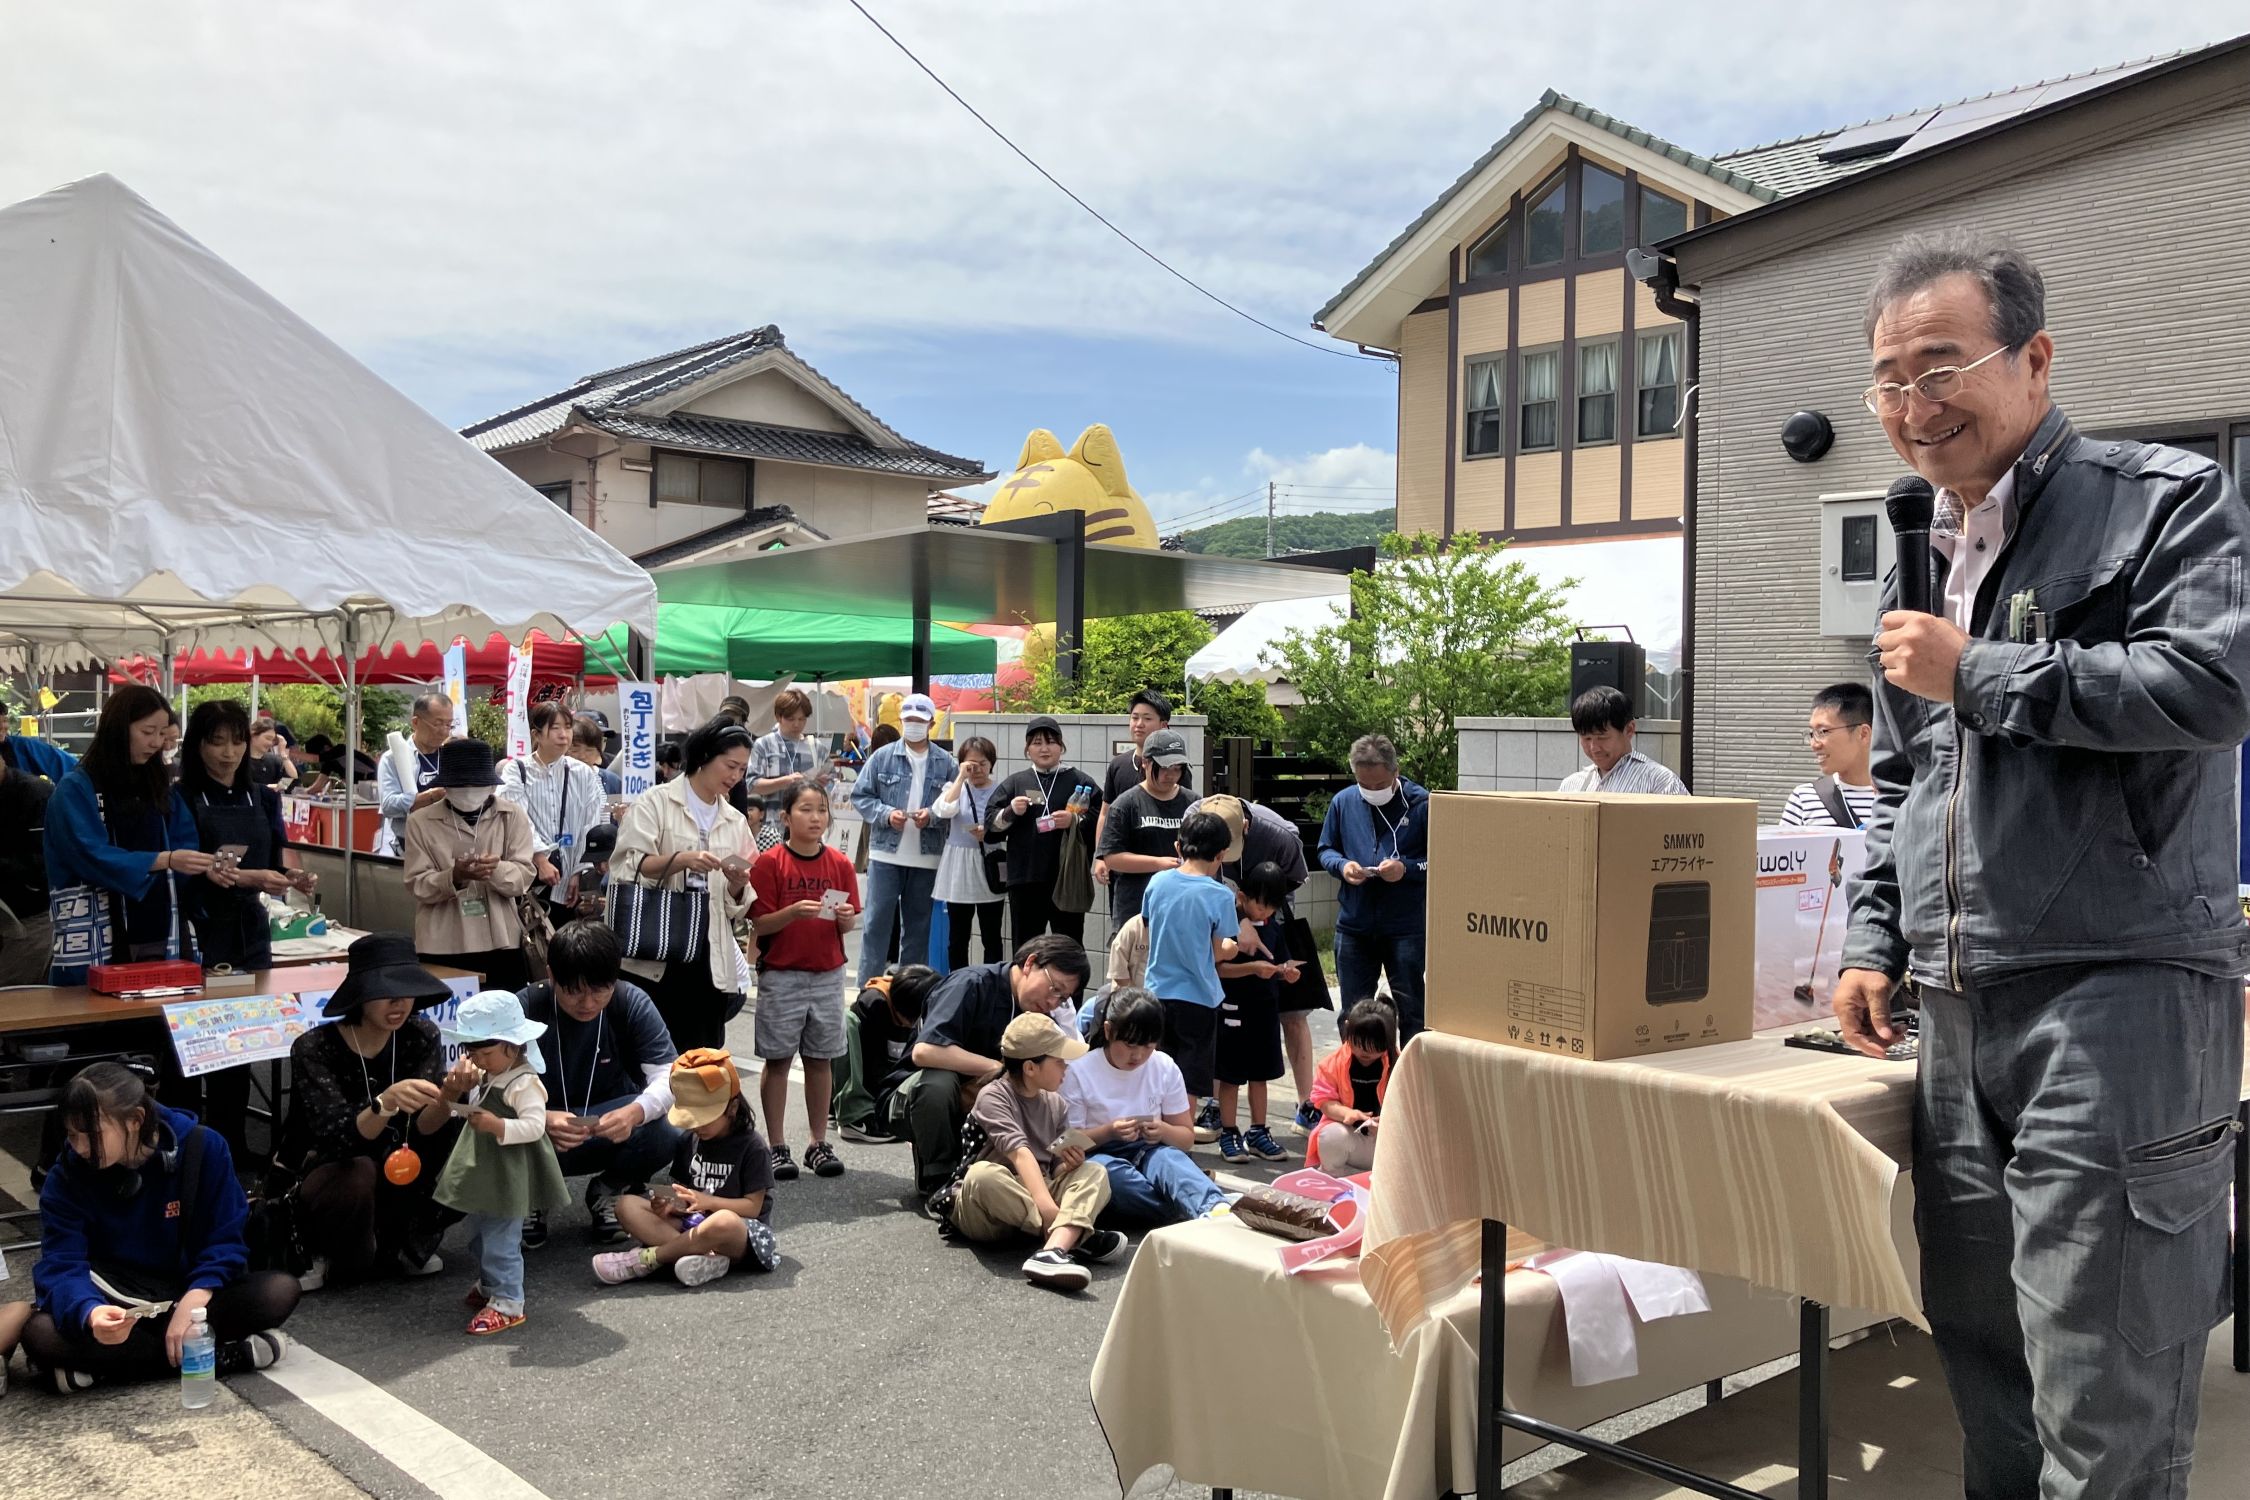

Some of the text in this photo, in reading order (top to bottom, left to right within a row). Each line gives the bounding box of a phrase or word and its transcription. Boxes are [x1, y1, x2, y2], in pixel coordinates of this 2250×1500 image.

[1664, 833, 1704, 849] SAMKYO
[1651, 856, 1714, 872] エアフライヤー
[788, 878, 832, 890] LAZIO
[1467, 912, 1548, 942] SAMKYO
